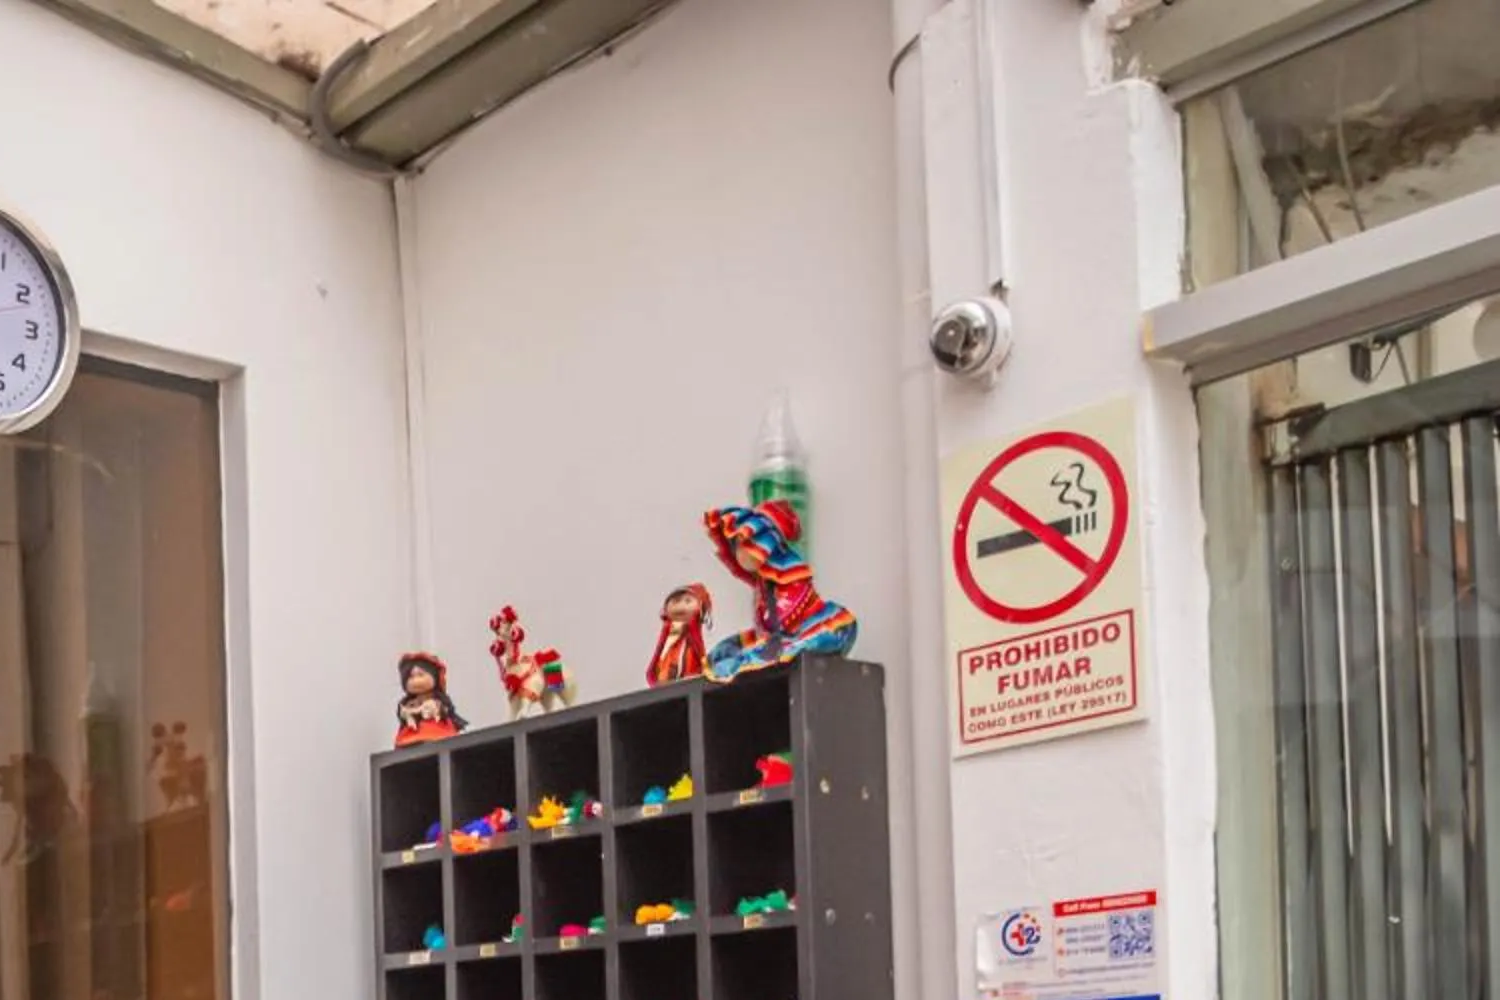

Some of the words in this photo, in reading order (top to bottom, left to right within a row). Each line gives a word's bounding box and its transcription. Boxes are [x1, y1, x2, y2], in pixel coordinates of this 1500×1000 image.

[16, 283, 30, 304] 2
[25, 320, 39, 340] 3
[12, 353, 26, 372] 4
[969, 622, 1121, 675] PROHIBIDO
[997, 657, 1091, 695] FUMAR
[968, 716, 1007, 734] COMO
[1011, 709, 1043, 725] ESTE
[1047, 702, 1076, 719] (LEY
[970, 704, 987, 718] EN
[990, 692, 1050, 713] LUGARES
